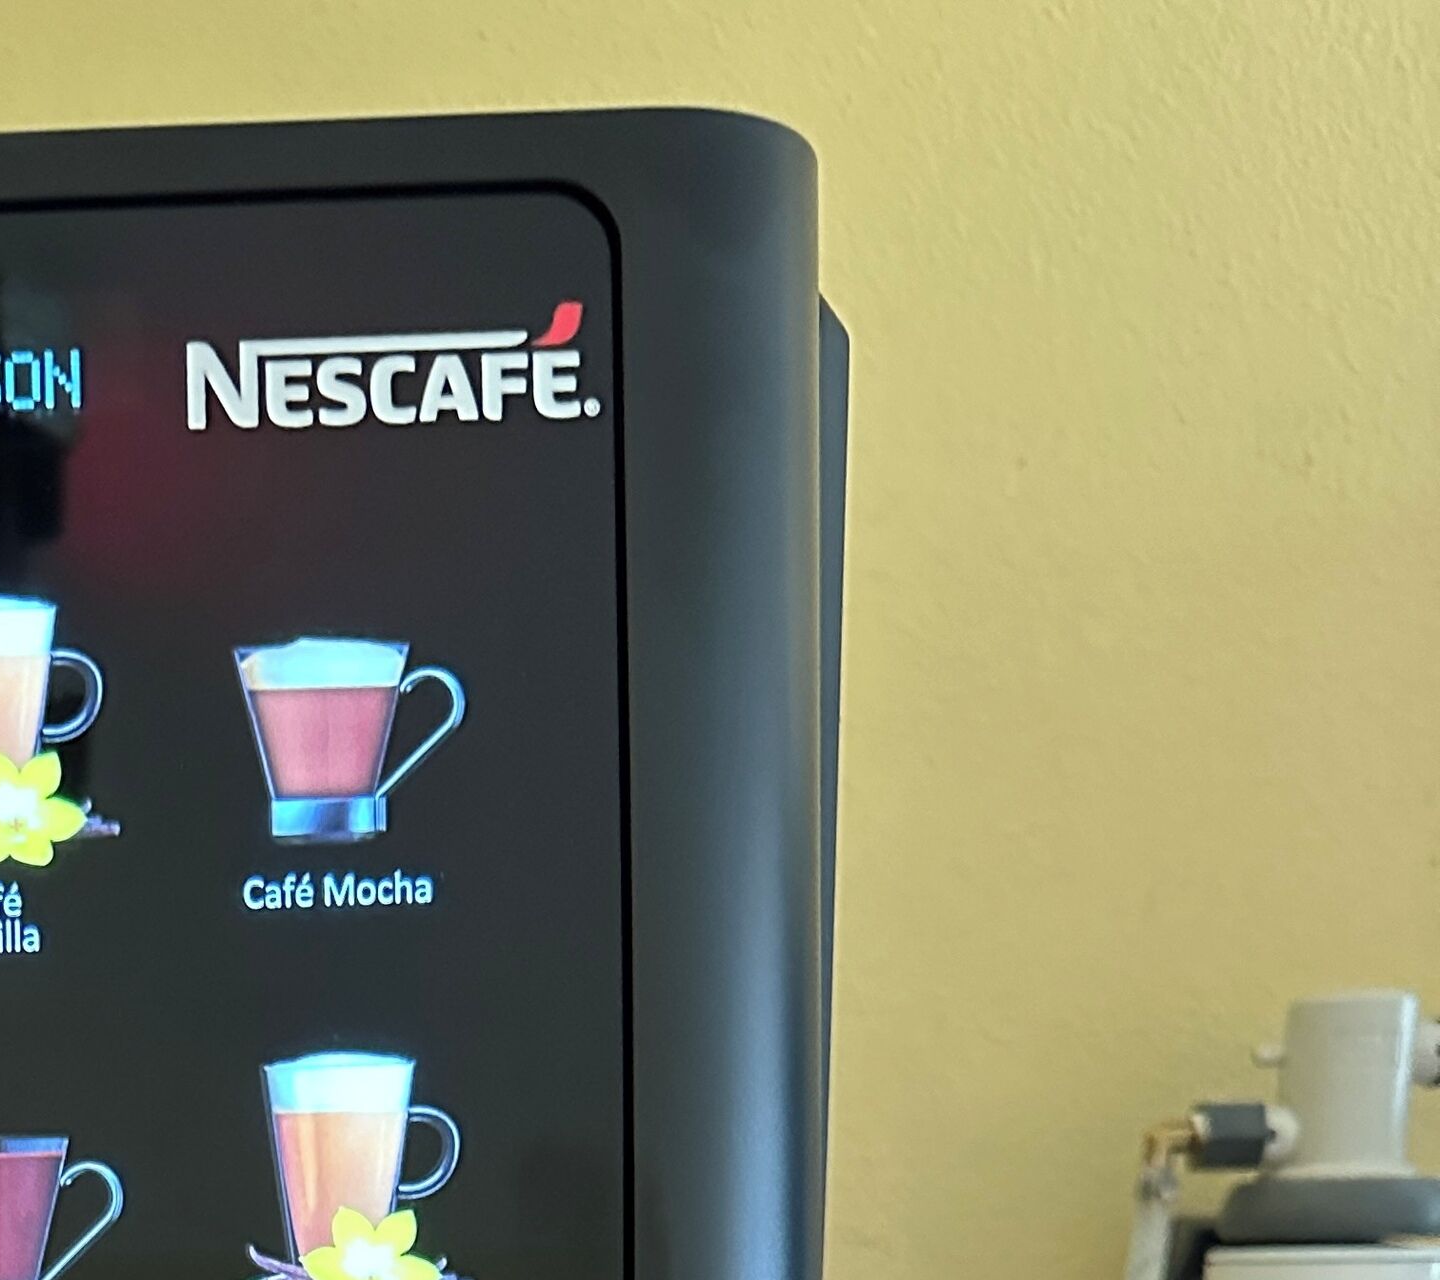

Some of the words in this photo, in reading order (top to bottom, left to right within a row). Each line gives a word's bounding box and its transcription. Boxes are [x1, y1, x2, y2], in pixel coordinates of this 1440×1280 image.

[186, 301, 584, 431] NESCAFÉ
[243, 872, 314, 911] Café
[323, 868, 435, 908] Mocha
